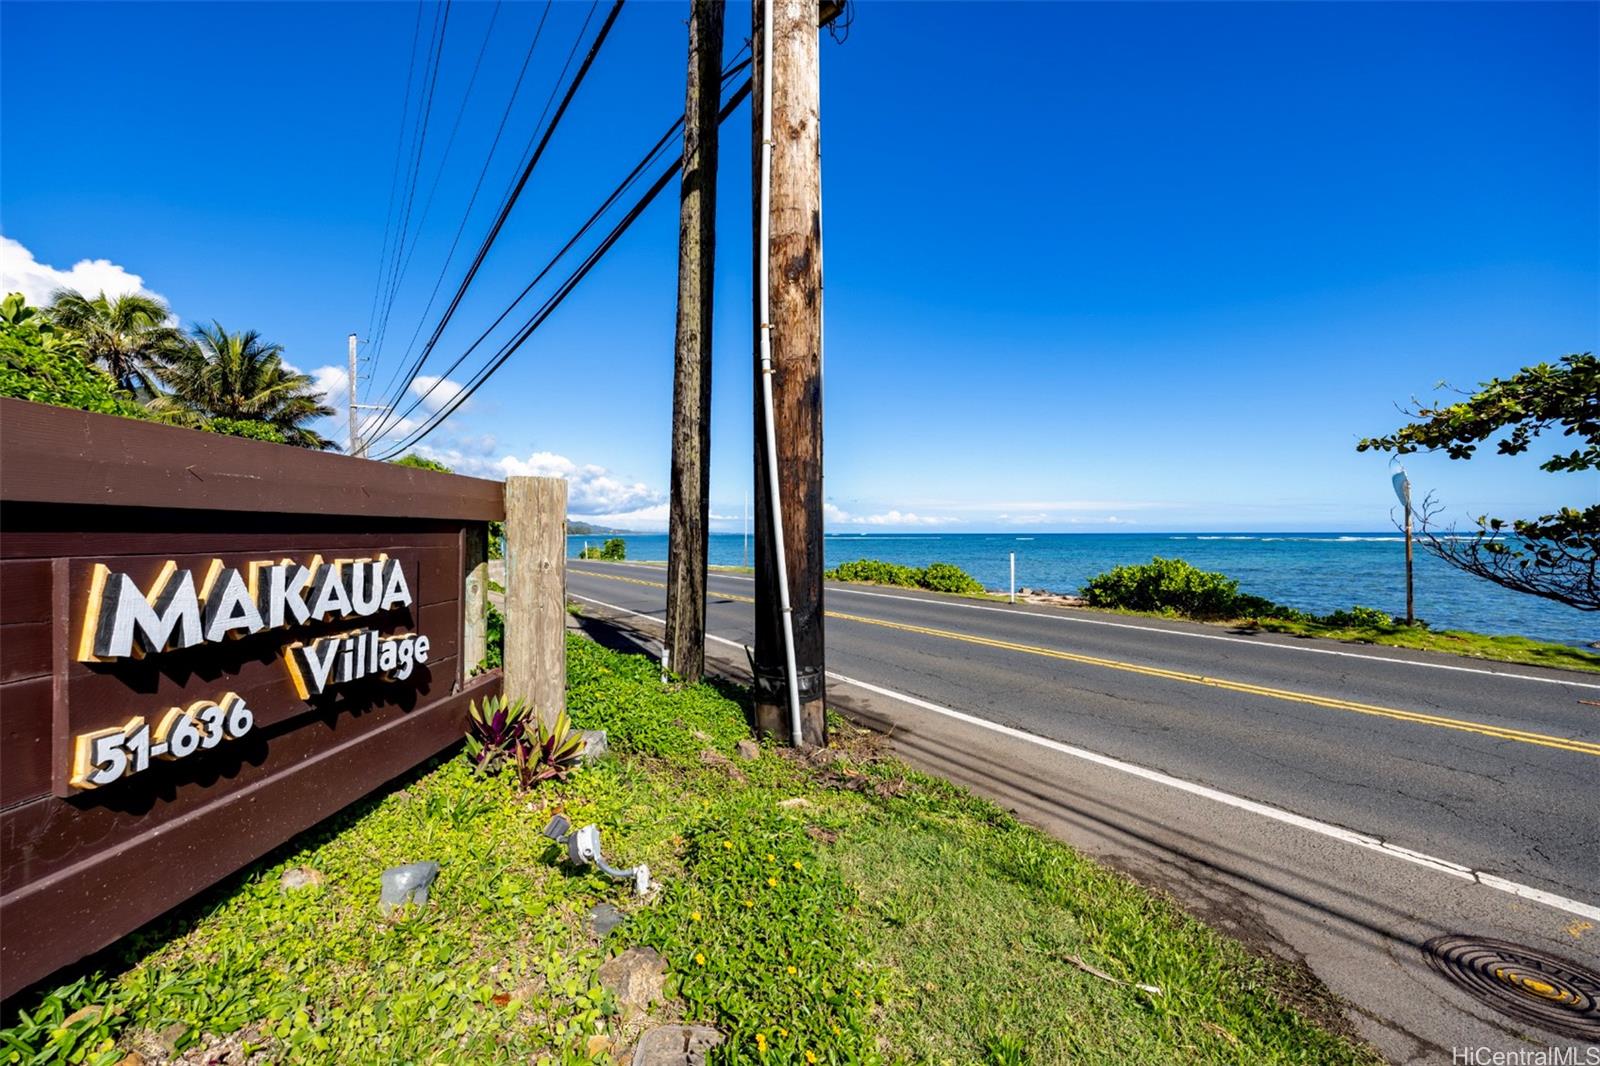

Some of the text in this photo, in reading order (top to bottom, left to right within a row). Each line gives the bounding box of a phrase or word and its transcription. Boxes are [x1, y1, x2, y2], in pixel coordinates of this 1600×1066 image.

[106, 558, 413, 658] MAKAUA
[302, 629, 431, 695] Village
[92, 697, 254, 785] 51-636
